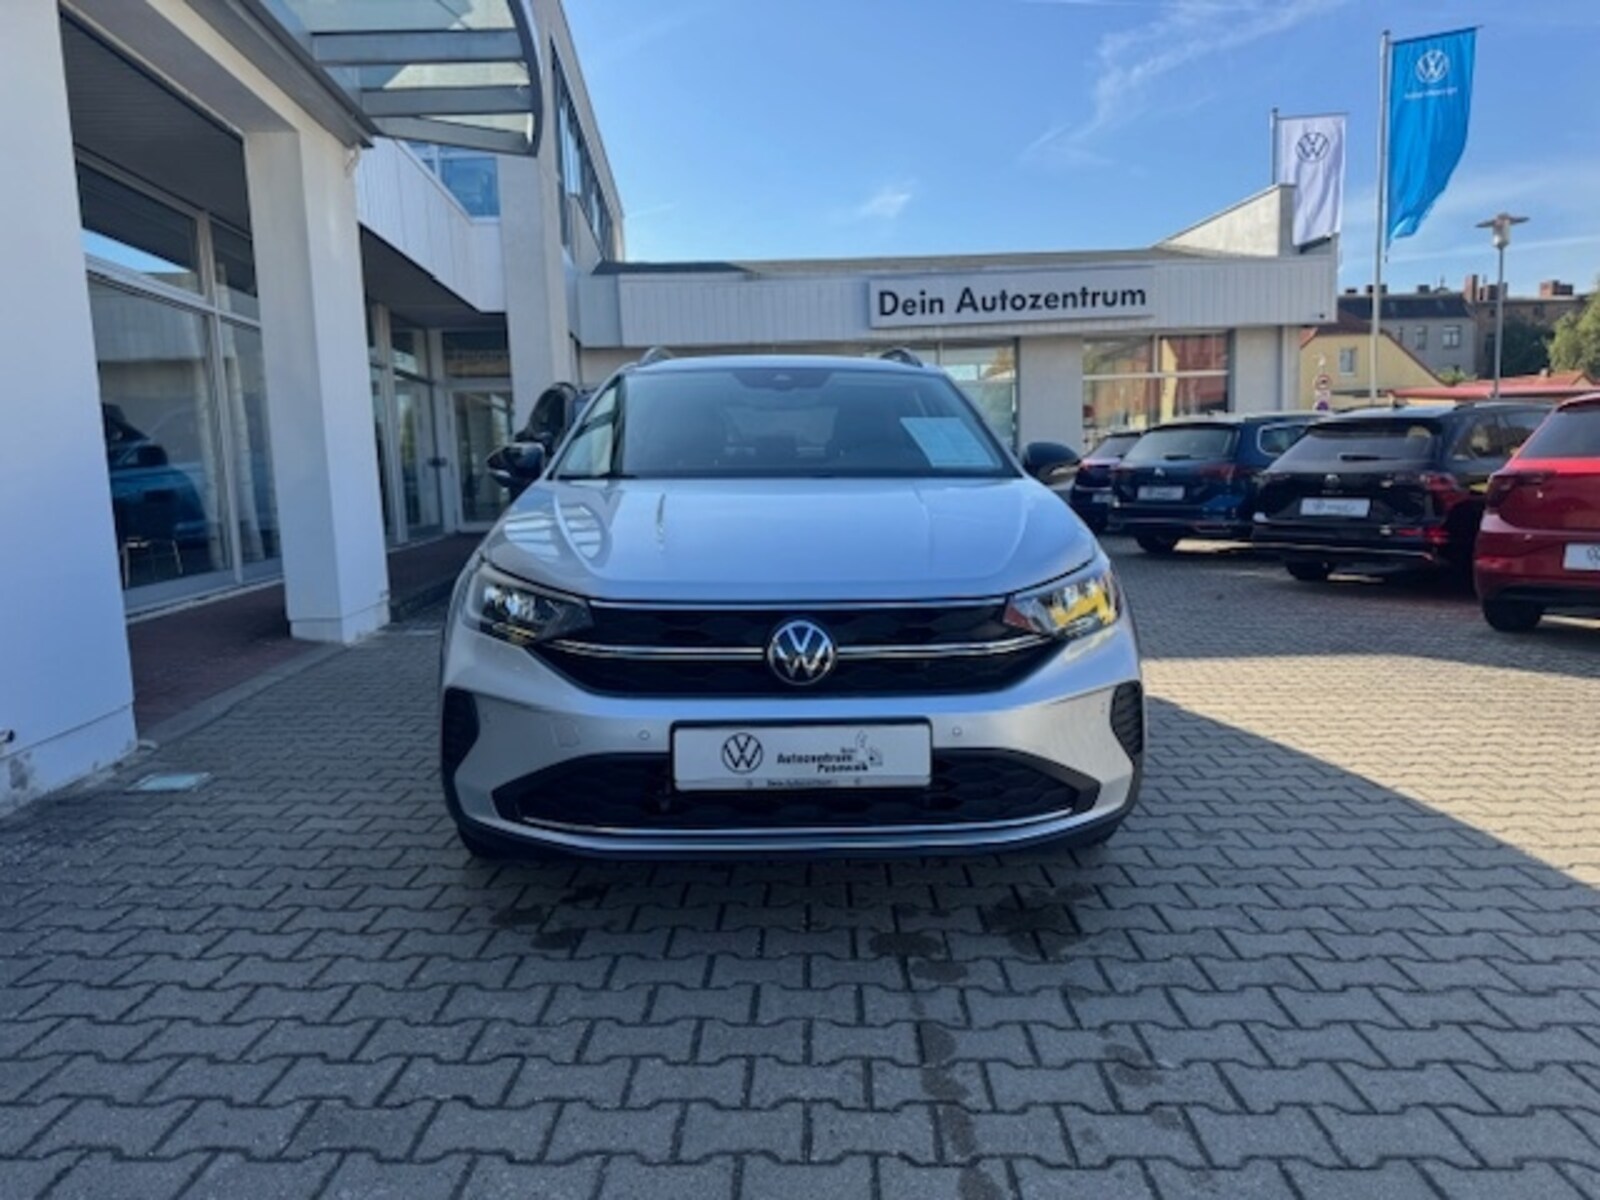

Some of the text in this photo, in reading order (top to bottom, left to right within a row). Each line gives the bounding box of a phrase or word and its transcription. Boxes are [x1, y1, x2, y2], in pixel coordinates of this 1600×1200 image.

[1416, 49, 1449, 83] VW
[1296, 132, 1330, 163] VW
[878, 286, 1147, 316] Dein Autozentrum
[768, 620, 834, 685] VW
[721, 732, 763, 774] VW
